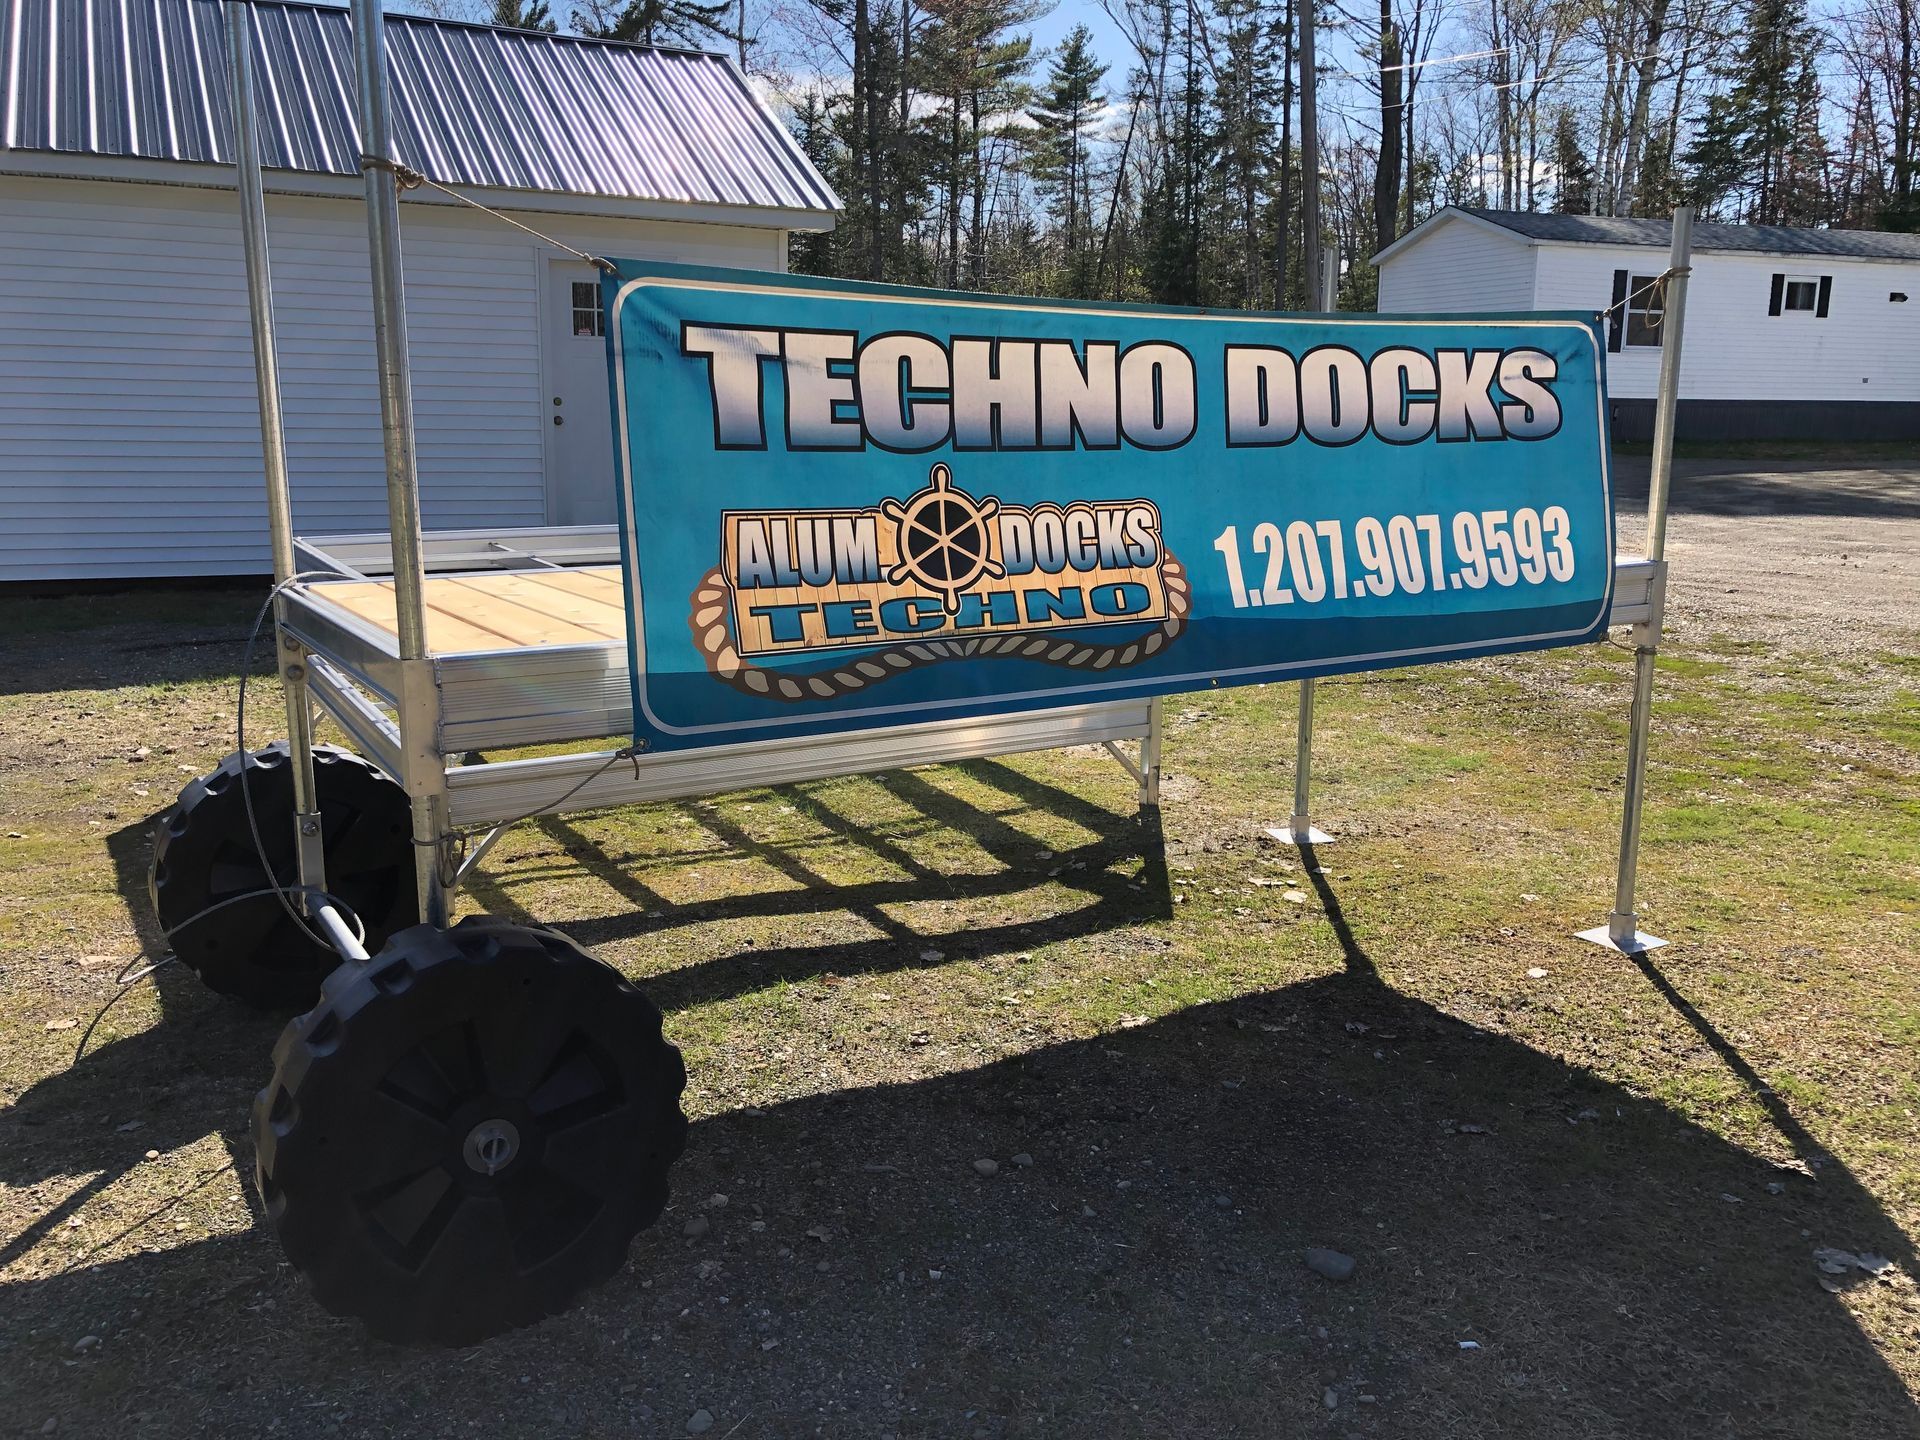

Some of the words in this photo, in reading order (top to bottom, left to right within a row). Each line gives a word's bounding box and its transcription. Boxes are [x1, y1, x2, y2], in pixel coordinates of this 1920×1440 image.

[681, 321, 1198, 453] TECHNO
[1224, 343, 1563, 448] DOCKS
[999, 507, 1157, 576] DOCKS
[1213, 506, 1575, 608] 1.207.907.9593
[749, 582, 1151, 643] TECHNO
